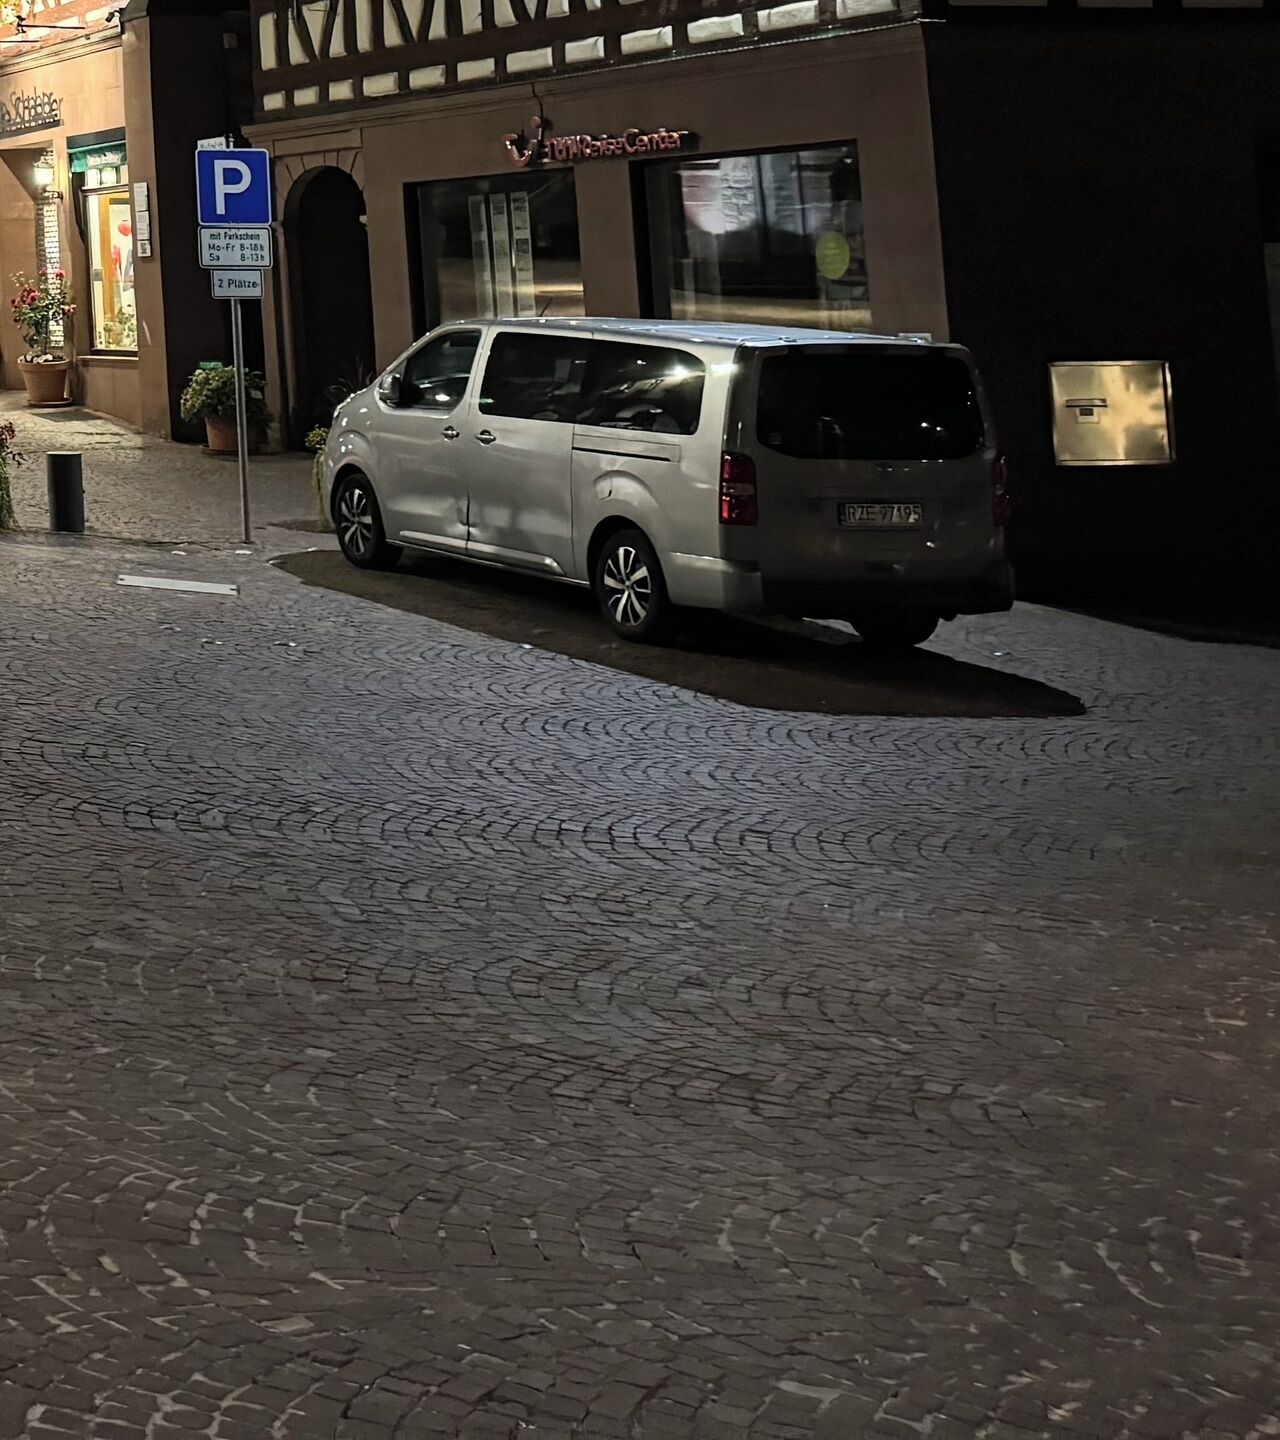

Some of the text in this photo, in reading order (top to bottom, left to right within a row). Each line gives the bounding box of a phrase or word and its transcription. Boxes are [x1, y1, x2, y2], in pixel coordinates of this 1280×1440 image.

[214, 159, 252, 215] P
[209, 231, 260, 241] mit Parkschein
[208, 243, 236, 252] Mo-Fr
[209, 253, 220, 262] Sa
[217, 278, 258, 289] 2 Plätze
